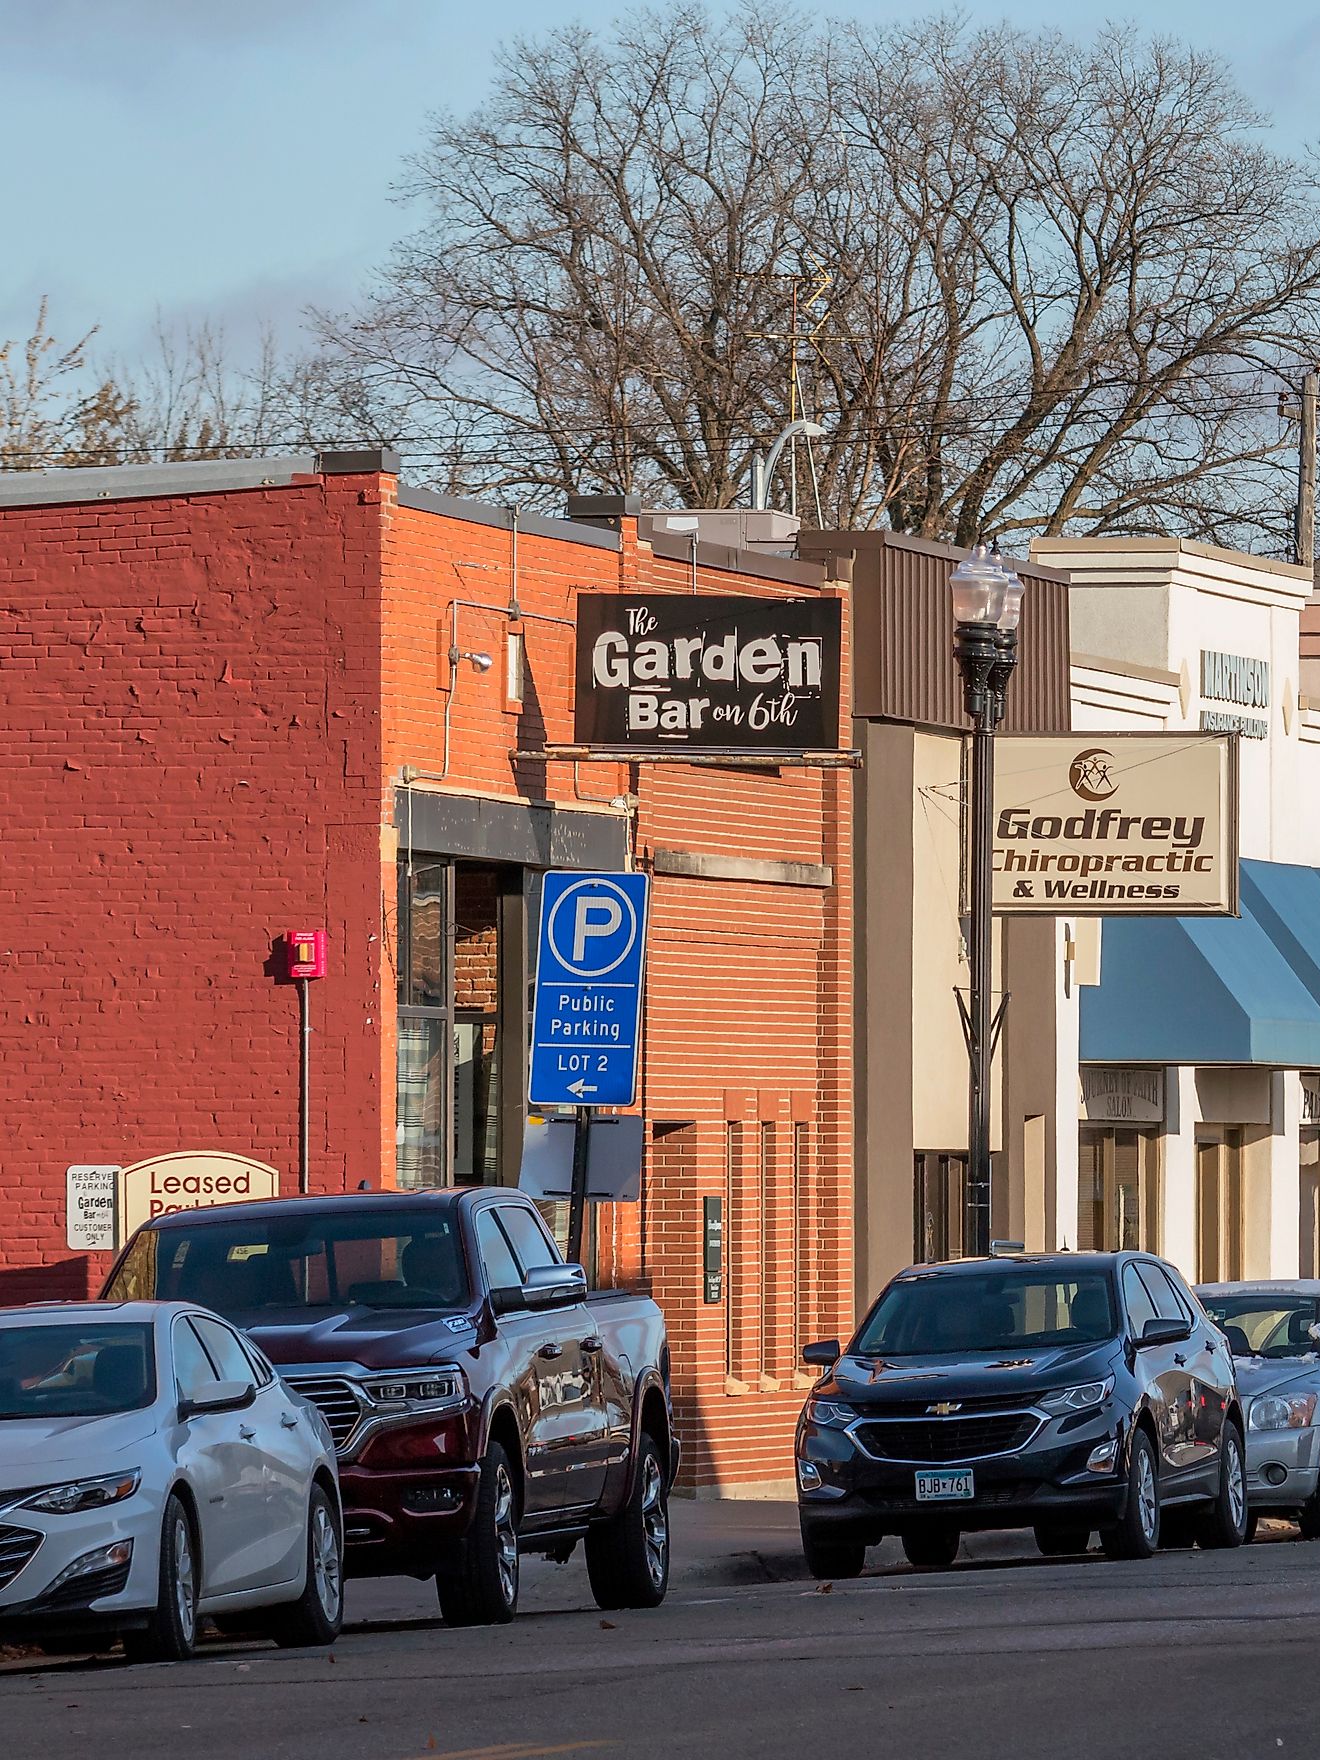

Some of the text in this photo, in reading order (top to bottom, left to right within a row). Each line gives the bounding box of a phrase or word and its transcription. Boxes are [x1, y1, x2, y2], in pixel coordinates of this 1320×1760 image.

[625, 607, 658, 635] The
[593, 630, 823, 688] Garden
[1200, 650, 1269, 708] MARTINSON
[628, 692, 799, 731] Bar on 6th
[996, 809, 1205, 848] Godfrey
[992, 849, 1213, 877] Chiropractic
[1012, 880, 1180, 899] & Wellness
[573, 896, 622, 961] P
[559, 995, 614, 1012] Public
[551, 1019, 620, 1041] Parking
[558, 1054, 608, 1072] LOT 2
[72, 1173, 114, 1181] RESERVE
[151, 1171, 250, 1194] Leased
[78, 1197, 113, 1209] Garden
[84, 1211, 96, 1219] Bar
[85, 1233, 105, 1241] ONLY
